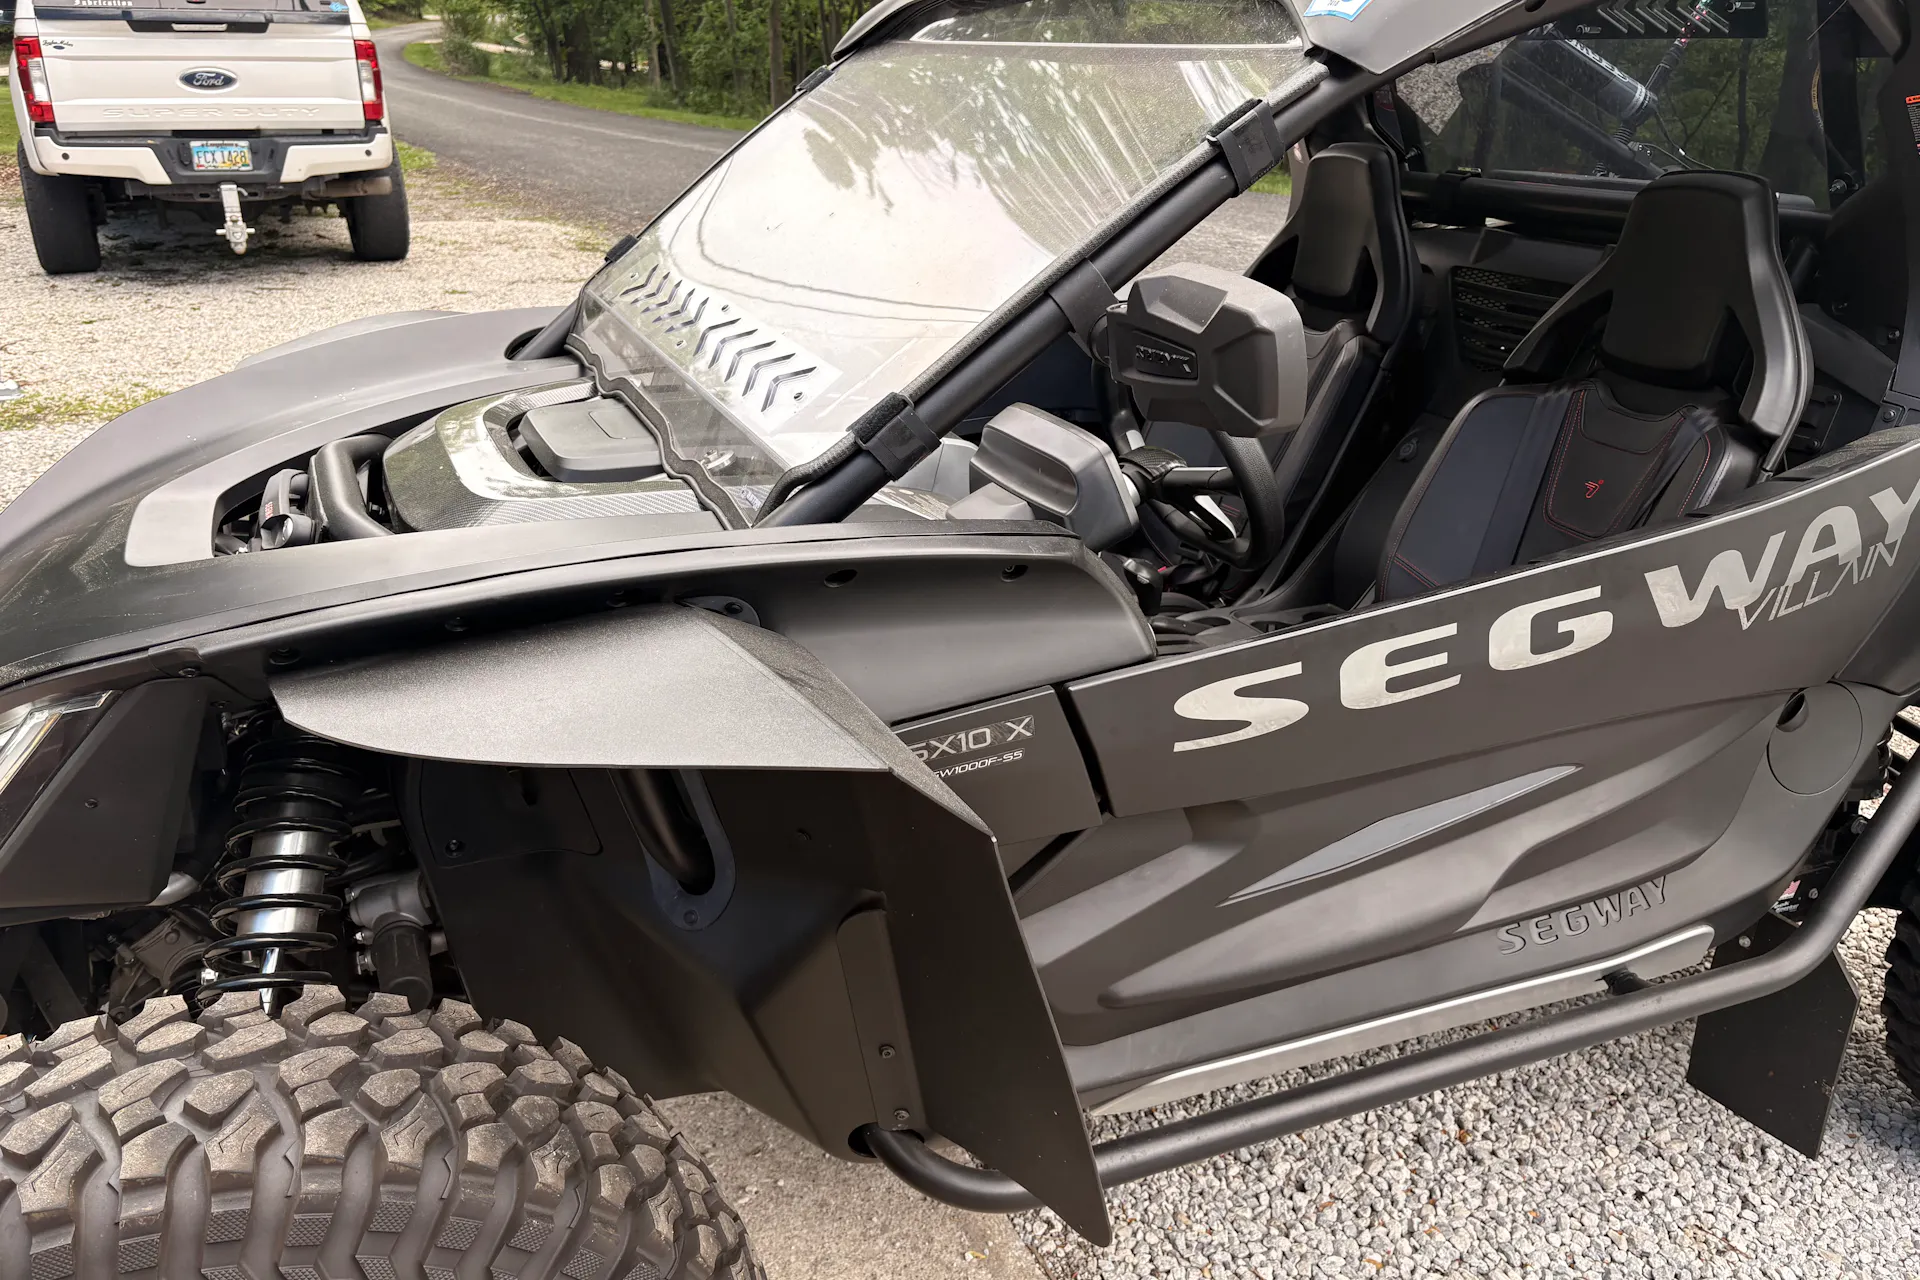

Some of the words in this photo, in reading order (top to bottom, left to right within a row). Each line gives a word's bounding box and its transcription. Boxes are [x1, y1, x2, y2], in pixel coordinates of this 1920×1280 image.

[192, 72, 225, 87] Ford
[103, 107, 224, 118] SUPER
[231, 107, 320, 118] DUTY
[196, 150, 218, 164] FCX
[221, 150, 247, 164] 1428
[1737, 537, 1901, 631] VILLAIN
[1173, 478, 1920, 753] SEGWAY
[1005, 716, 1033, 742] X
[1496, 875, 1668, 956] SEGWAY
